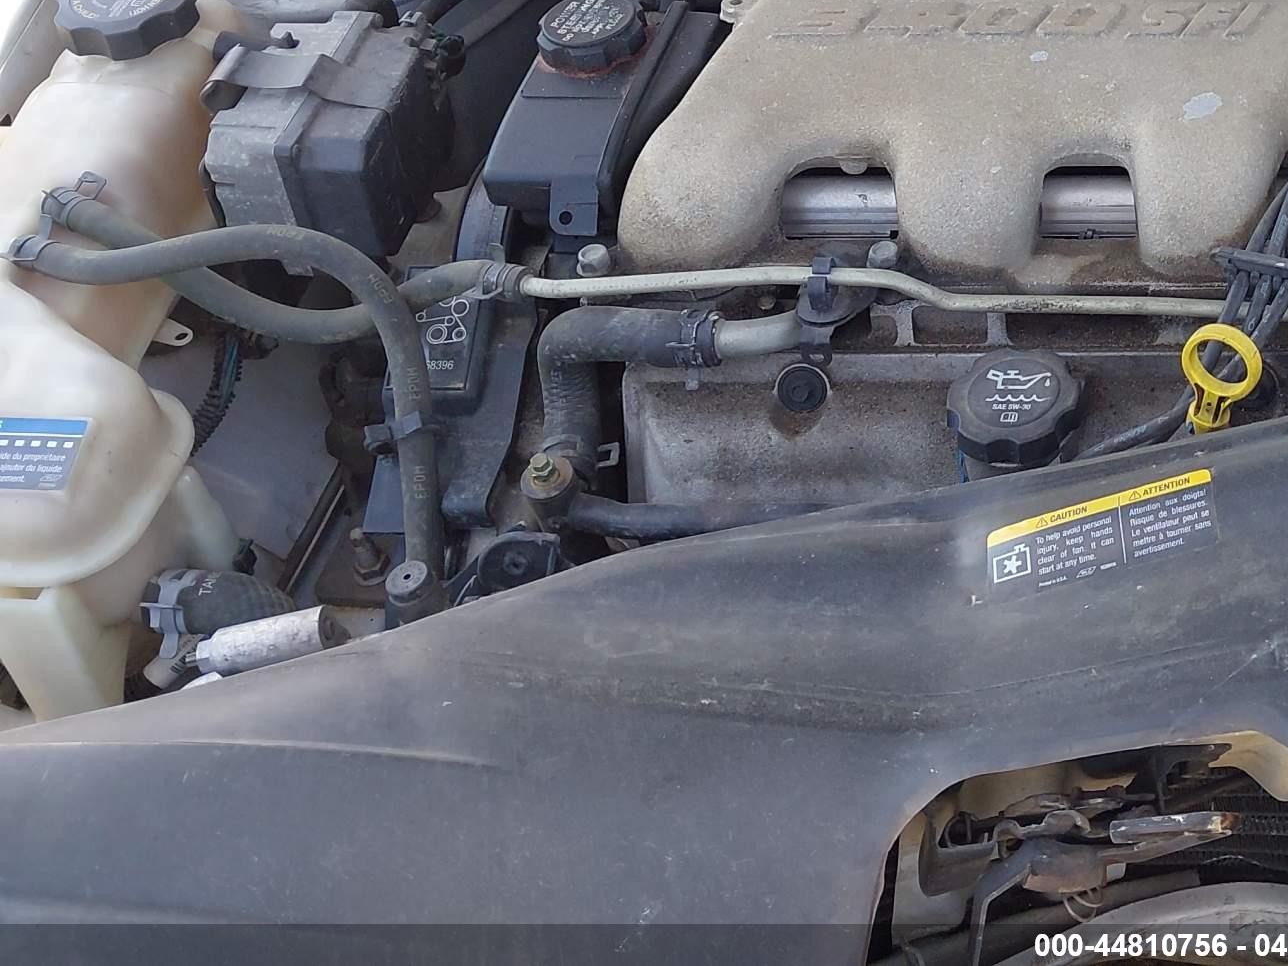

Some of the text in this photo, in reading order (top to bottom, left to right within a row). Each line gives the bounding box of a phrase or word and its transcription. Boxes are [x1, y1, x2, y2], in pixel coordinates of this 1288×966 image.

[550, 1, 580, 28] POWER
[768, 1, 1268, 41] 3400 SFI
[368, 273, 394, 304] EPDM
[408, 366, 420, 400] EPDM
[414, 465, 428, 499] EPDM
[1142, 476, 1190, 496] ATTENTION
[1050, 506, 1088, 523] CAUTION
[1129, 488, 1207, 516] Attention aux doigts!
[1130, 500, 1208, 526] Risque de blessures.
[1036, 516, 1112, 545] To help avoid personal
[1131, 509, 1210, 537] Le ventilateur peut se
[1133, 520, 1212, 548] mettre à tourner sans
[1037, 527, 1113, 556] injury, keep hands
[1038, 554, 1055, 565] clear
[1060, 550, 1067, 559] of
[1100, 537, 1114, 546] can
[1134, 537, 1184, 558] avertissement.
[1038, 554, 1096, 576] start at any time.
